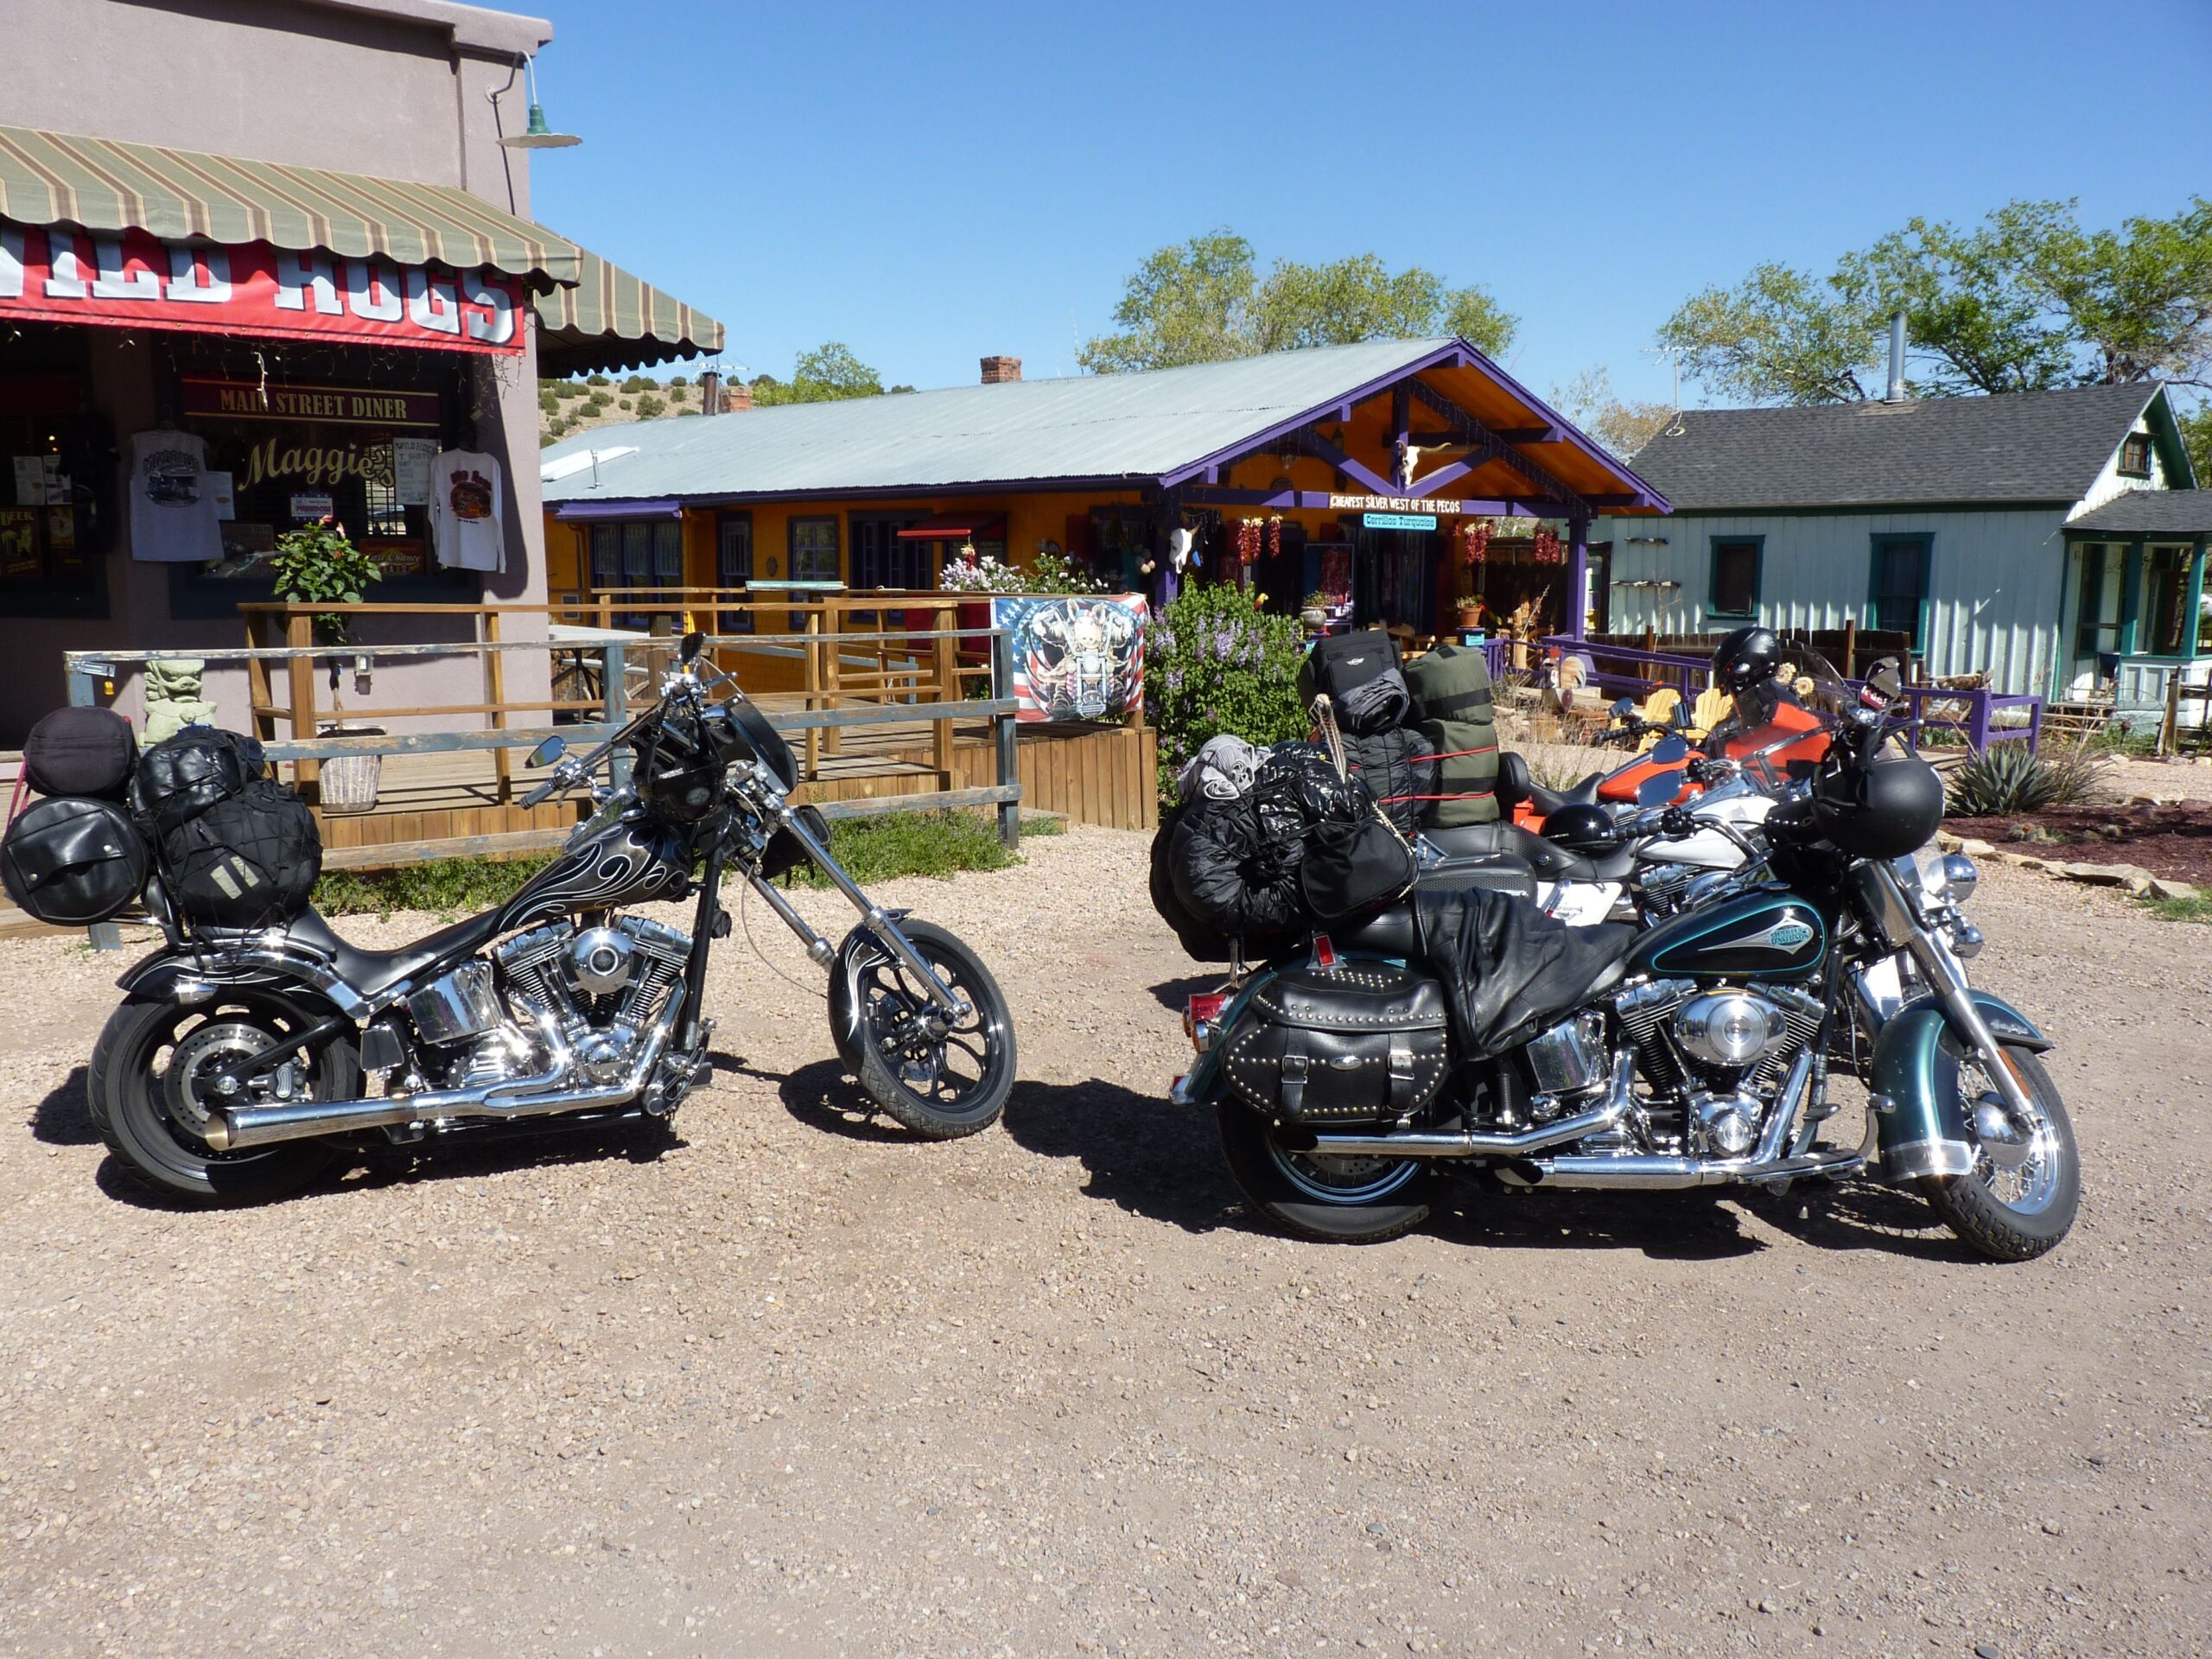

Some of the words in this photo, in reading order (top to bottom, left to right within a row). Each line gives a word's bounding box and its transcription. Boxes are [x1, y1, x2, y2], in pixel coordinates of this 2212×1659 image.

[0, 223, 232, 303] ILD
[274, 250, 516, 345] HOGS
[220, 390, 268, 412] MAIN
[276, 392, 345, 416] STREET
[352, 396, 407, 419] DINER
[238, 438, 395, 491] Maggie's
[1331, 493, 1364, 508] CHEAPEST
[1389, 497, 1410, 511] WEST
[1411, 499, 1421, 512] OF
[1421, 499, 1435, 512] THE
[1437, 500, 1460, 513] PECOS
